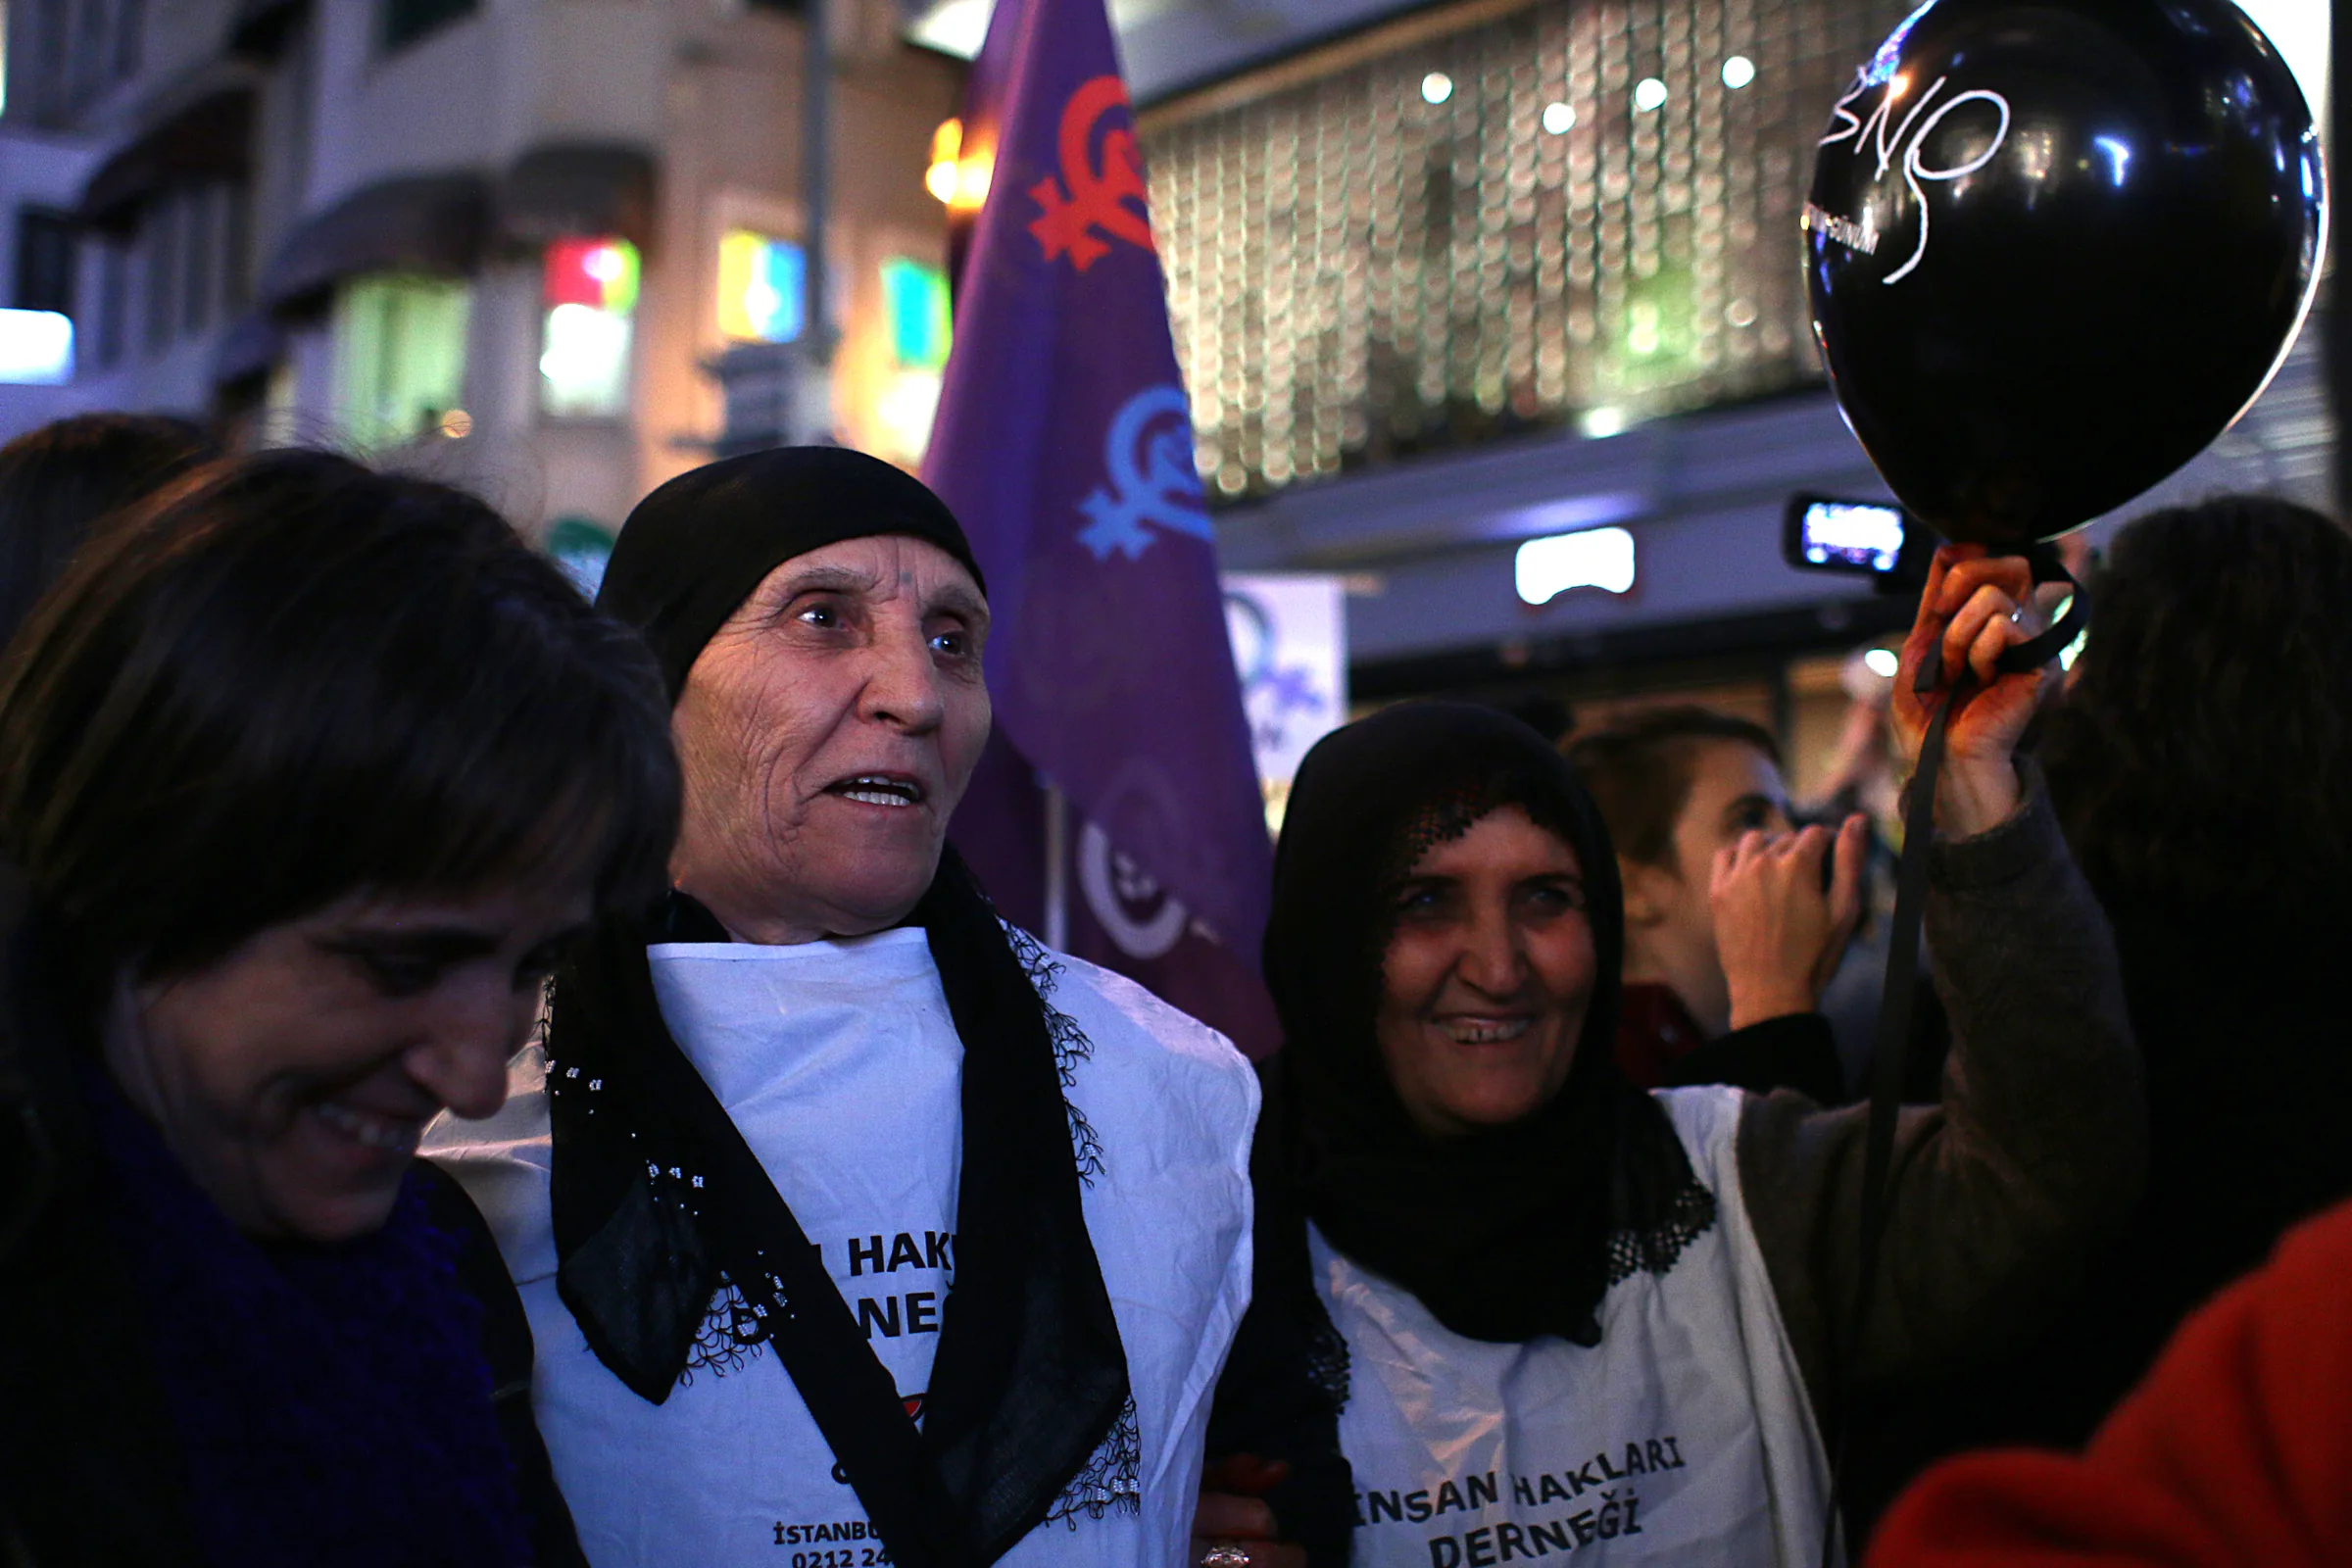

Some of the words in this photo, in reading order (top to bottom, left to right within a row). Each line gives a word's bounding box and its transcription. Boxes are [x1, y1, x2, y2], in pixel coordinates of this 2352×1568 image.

[849, 1231, 957, 1276] HAK
[1511, 1437, 1685, 1506] HAKLARI
[1428, 1488, 1642, 1568] DERNEĞİ
[791, 1549, 854, 1568] 0212
